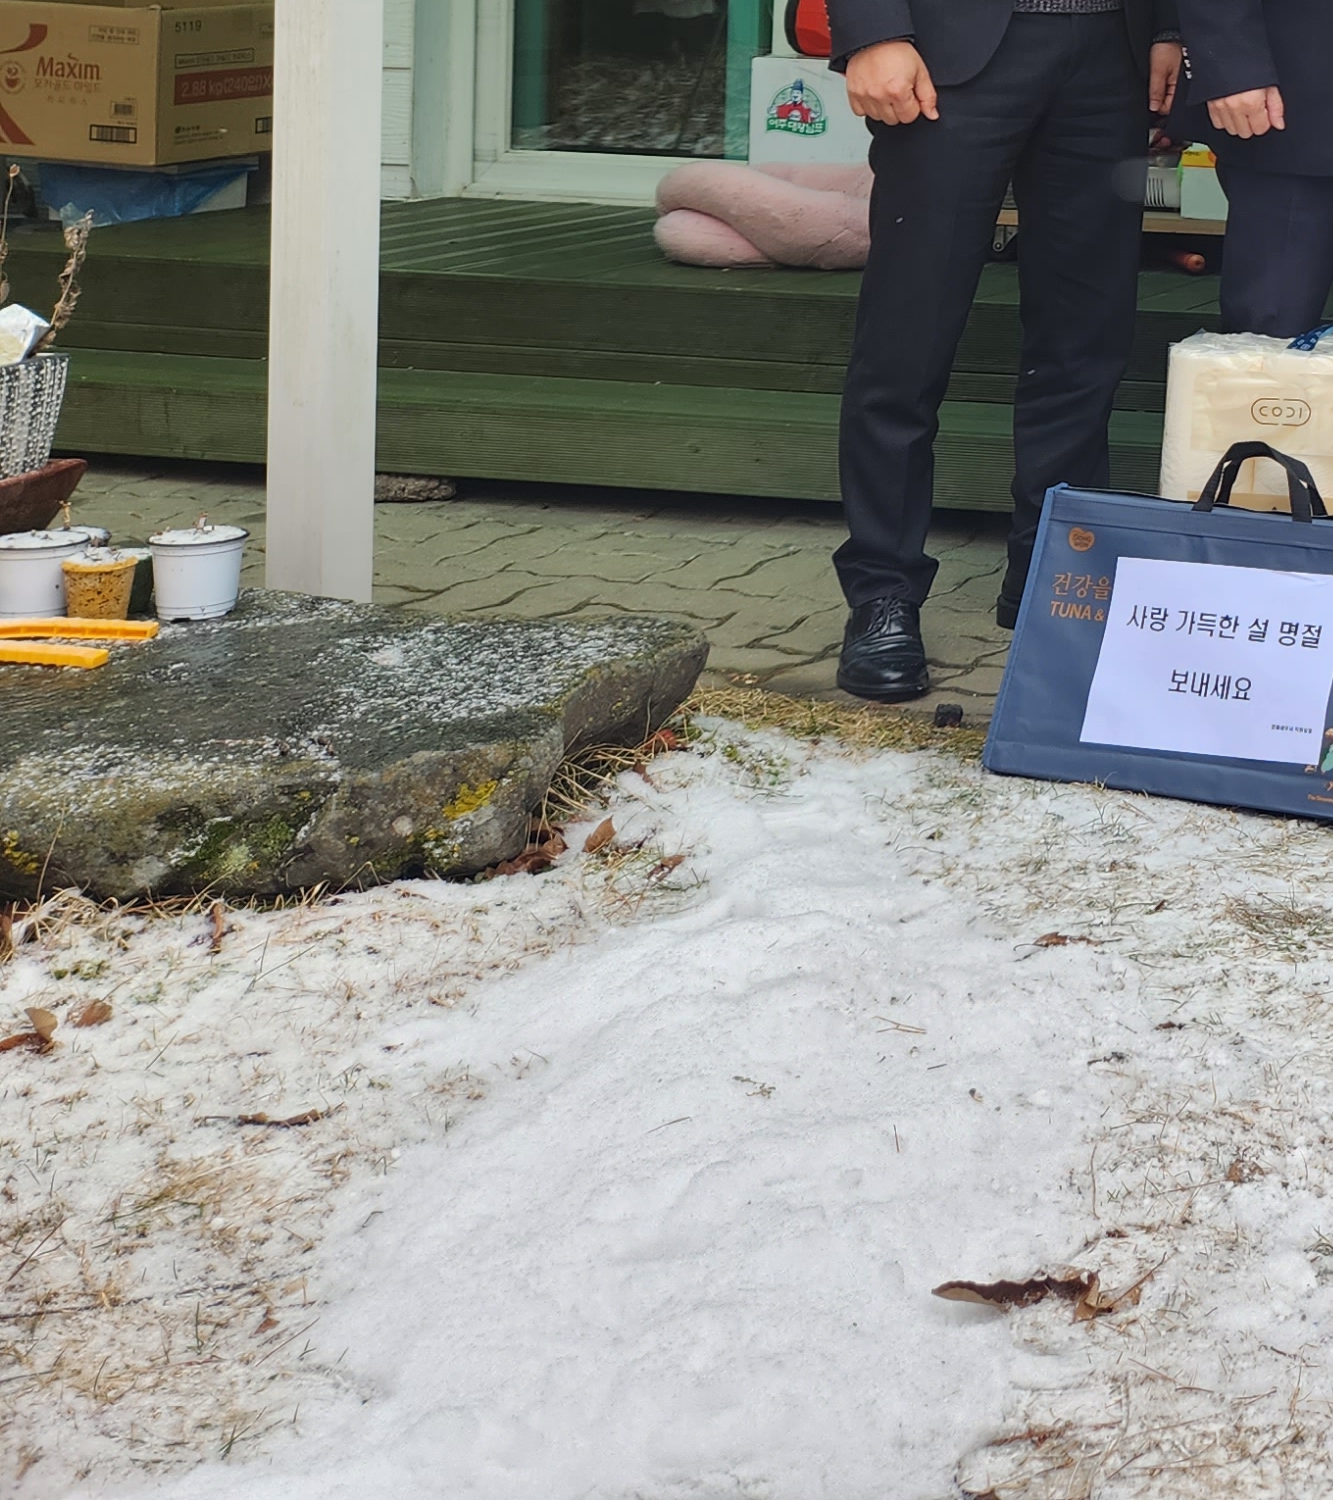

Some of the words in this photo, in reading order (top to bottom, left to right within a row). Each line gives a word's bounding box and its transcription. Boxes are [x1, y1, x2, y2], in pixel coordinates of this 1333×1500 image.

[175, 20, 202, 33] 5119
[36, 53, 100, 81] Maxim
[1052, 571, 1112, 600] 건강을
[1050, 600, 1092, 620] TUNA
[1094, 608, 1105, 622] &
[1127, 605, 1168, 631] 사랑
[1176, 611, 1239, 639] 가득한
[1248, 619, 1269, 642] 설
[1279, 622, 1322, 648] 명절
[1169, 670, 1251, 700] 보내세요
